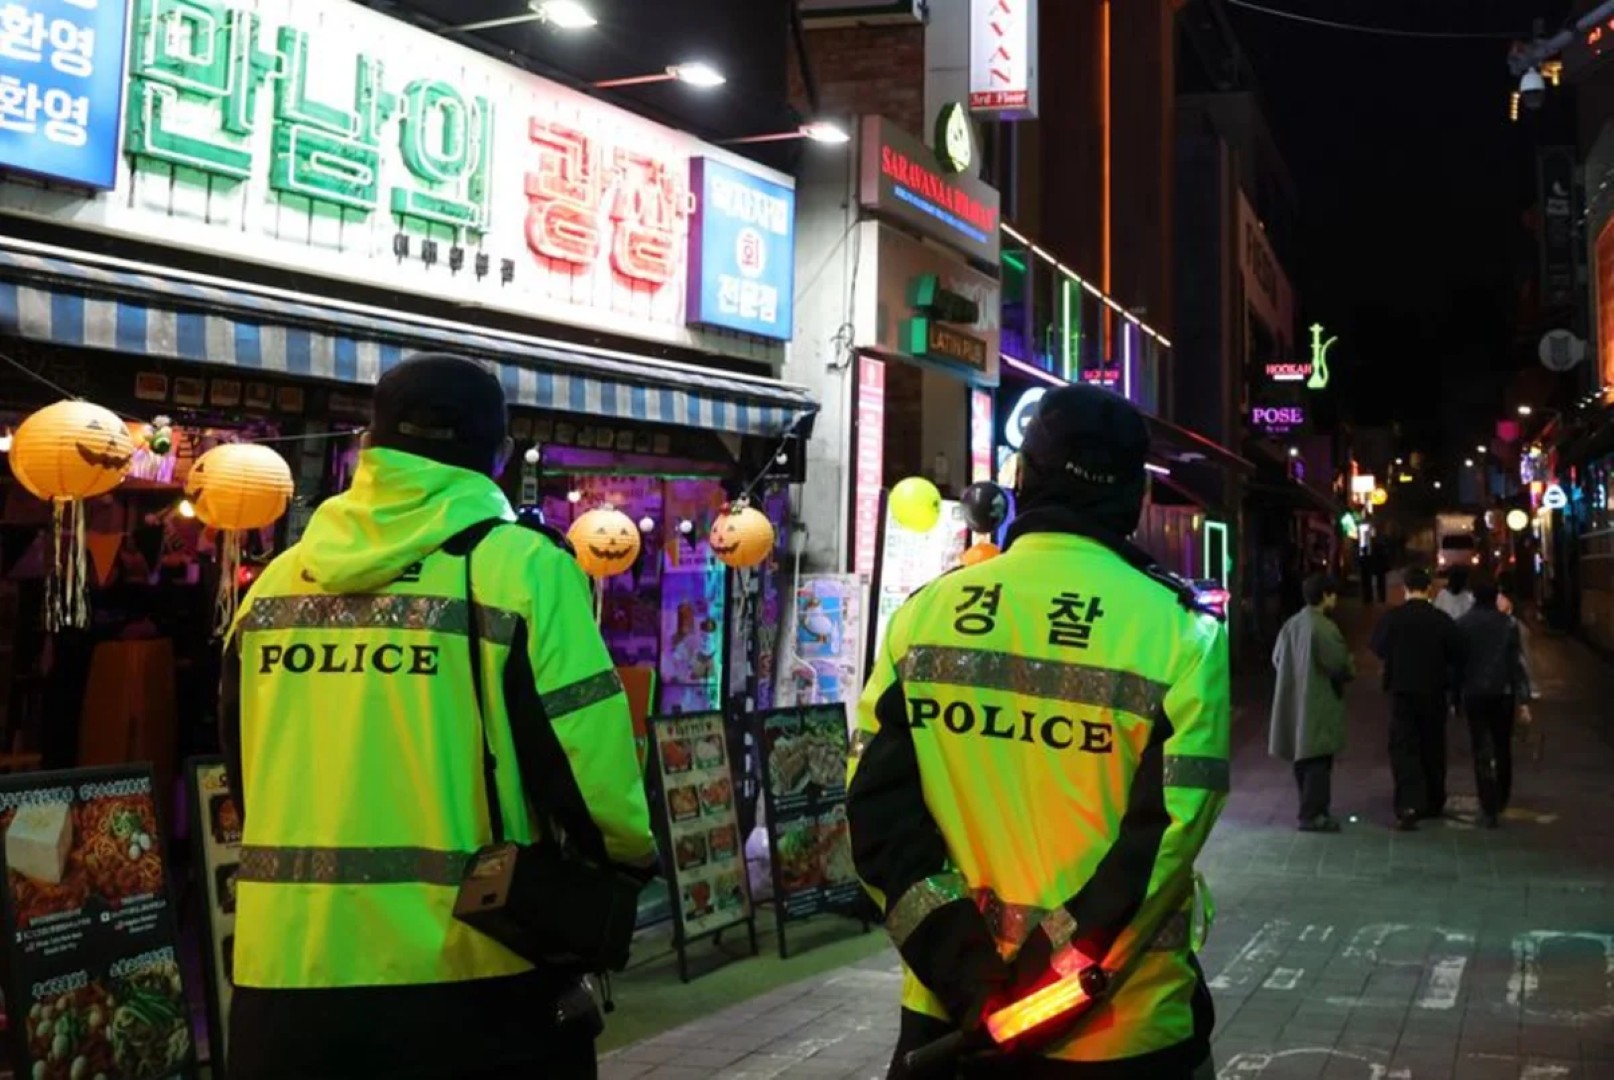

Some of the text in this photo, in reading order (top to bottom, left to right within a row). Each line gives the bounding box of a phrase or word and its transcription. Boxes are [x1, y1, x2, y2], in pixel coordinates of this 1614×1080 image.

[0, 3, 96, 78] 환영
[0, 75, 90, 146] 환영
[122, 0, 695, 293] 만남의 광장
[718, 273, 778, 324] 전문점
[1265, 363, 1312, 375] HOOKAH
[1252, 406, 1304, 424] POSE
[258, 642, 440, 676] POLICE
[909, 697, 1114, 755] POLICE
